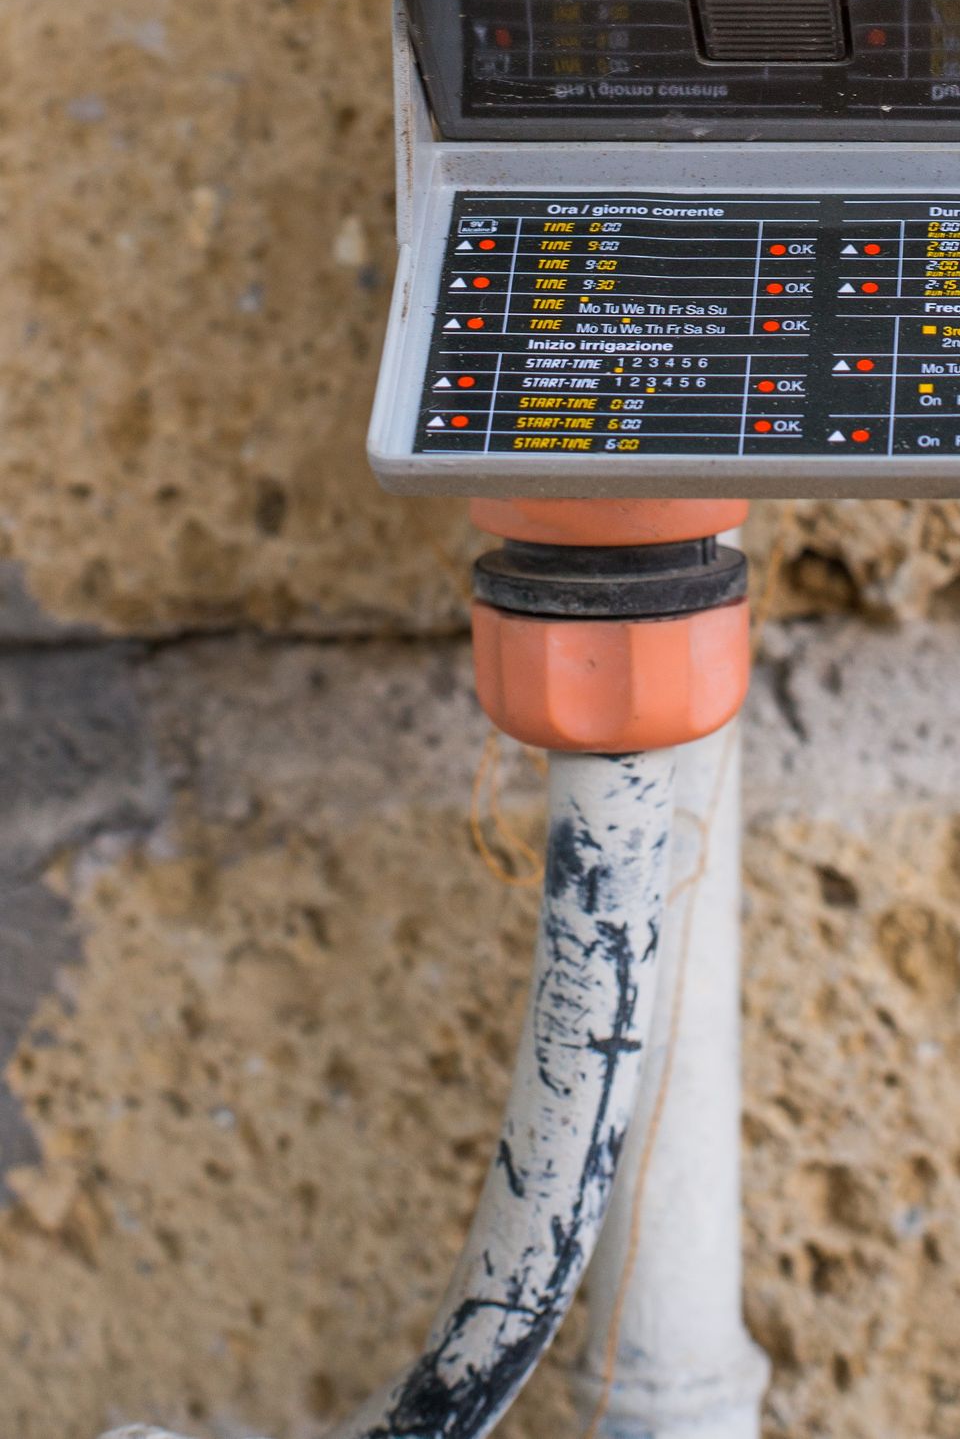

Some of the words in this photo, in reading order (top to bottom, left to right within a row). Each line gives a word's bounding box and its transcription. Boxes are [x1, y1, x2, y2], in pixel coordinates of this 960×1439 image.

[547, 204, 578, 215] Ora
[592, 205, 648, 217] giorno
[652, 207, 725, 217] corrente
[543, 222, 575, 233] TIME
[540, 241, 573, 251] TIME
[788, 244, 816, 254] O.K.
[537, 259, 570, 270] TIME
[535, 279, 568, 290] TIME
[785, 282, 813, 293] O.K.
[532, 298, 565, 310] TIME
[579, 304, 601, 315] Mo
[603, 304, 620, 315] Tu
[621, 304, 645, 315] We
[647, 304, 665, 315] Th
[668, 304, 682, 315] Fr
[685, 304, 704, 315] Sa
[707, 304, 727, 315] Su
[530, 319, 563, 330] TIME
[576, 324, 599, 335] Mo
[601, 324, 617, 335] Tu
[619, 324, 643, 335] We
[645, 324, 663, 335] Th
[666, 324, 680, 335] Fr
[683, 324, 703, 335] Sa
[705, 324, 726, 335] Su
[781, 320, 810, 331] O.K.
[528, 339, 576, 350] Inizio
[580, 340, 674, 353] irrigazione
[525, 358, 603, 369] START-TIME
[618, 358, 625, 368] 1
[632, 358, 643, 368] 2
[648, 358, 659, 368] 3
[665, 358, 675, 368] 4
[681, 358, 692, 368] 5
[698, 358, 708, 368] 6
[921, 363, 944, 374] Mo
[522, 377, 600, 389] START-TIME
[615, 377, 622, 387] 1
[629, 377, 640, 387] 2
[646, 377, 657, 387] 3
[662, 377, 673, 387] 4
[679, 377, 690, 387] 5
[695, 377, 706, 387] 6
[777, 380, 806, 391] O.K.
[519, 397, 597, 409] START-TIME
[919, 394, 942, 406] On
[516, 416, 596, 429] START-TIME
[773, 420, 802, 432] O.K.
[513, 437, 593, 449] START-TIME
[917, 435, 940, 447] On
